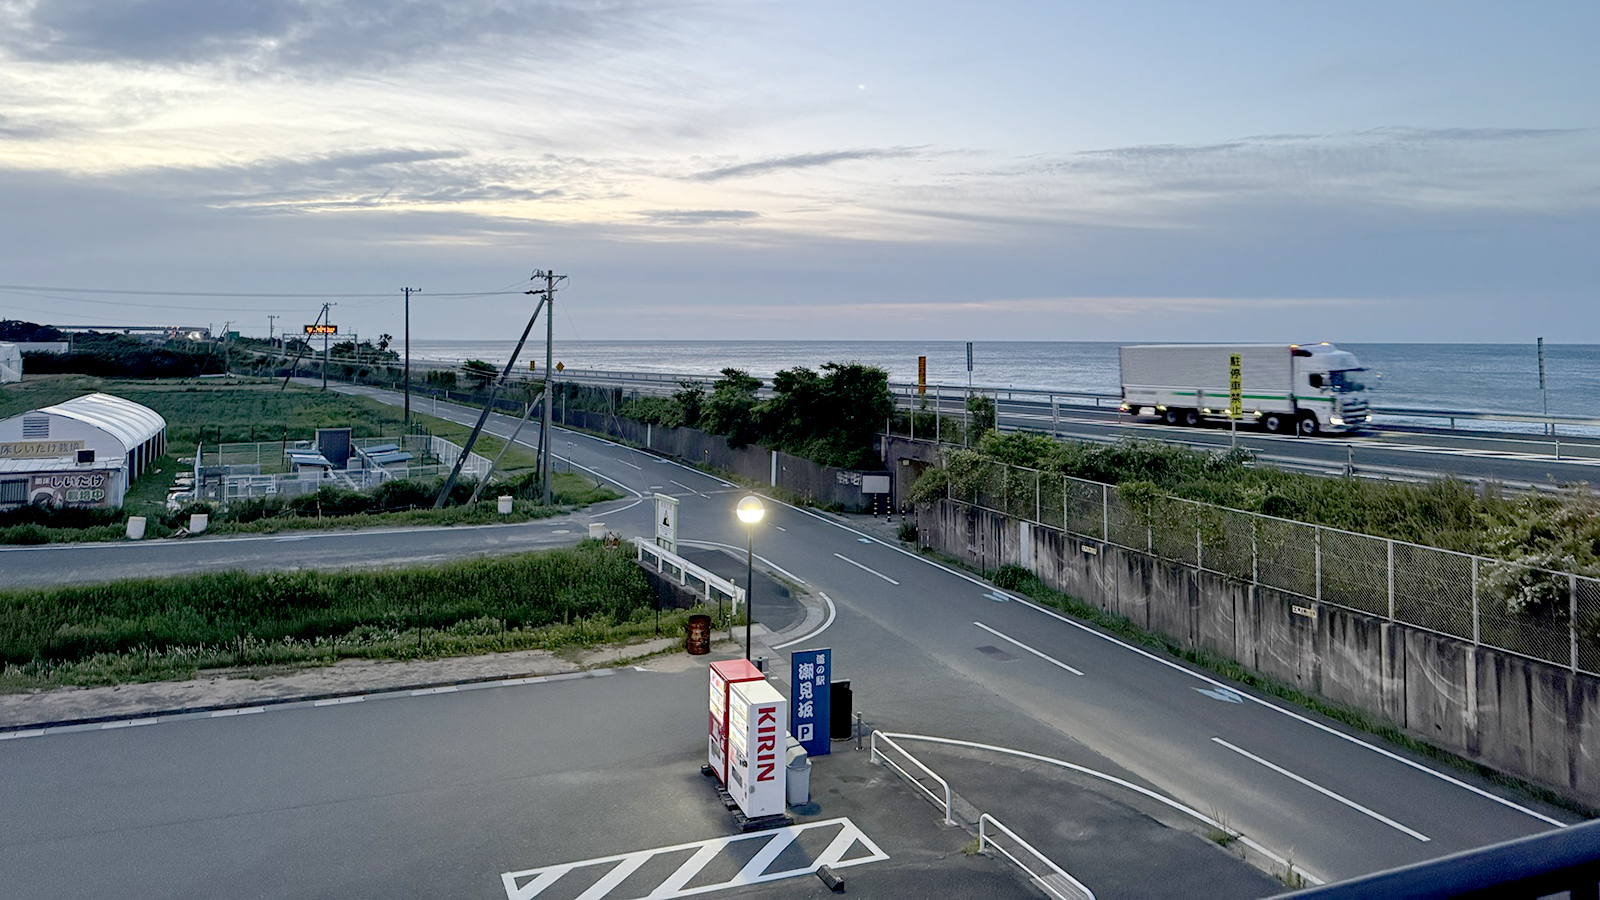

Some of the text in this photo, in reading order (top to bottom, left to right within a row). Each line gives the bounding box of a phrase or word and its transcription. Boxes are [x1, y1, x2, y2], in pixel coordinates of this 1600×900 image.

[1230, 356, 1241, 415] 駐停車禁止
[798, 662, 814, 719] 潮見坂
[815, 654, 826, 686] 道の駅
[757, 706, 776, 782] KIRIN
[801, 726, 810, 740] P
